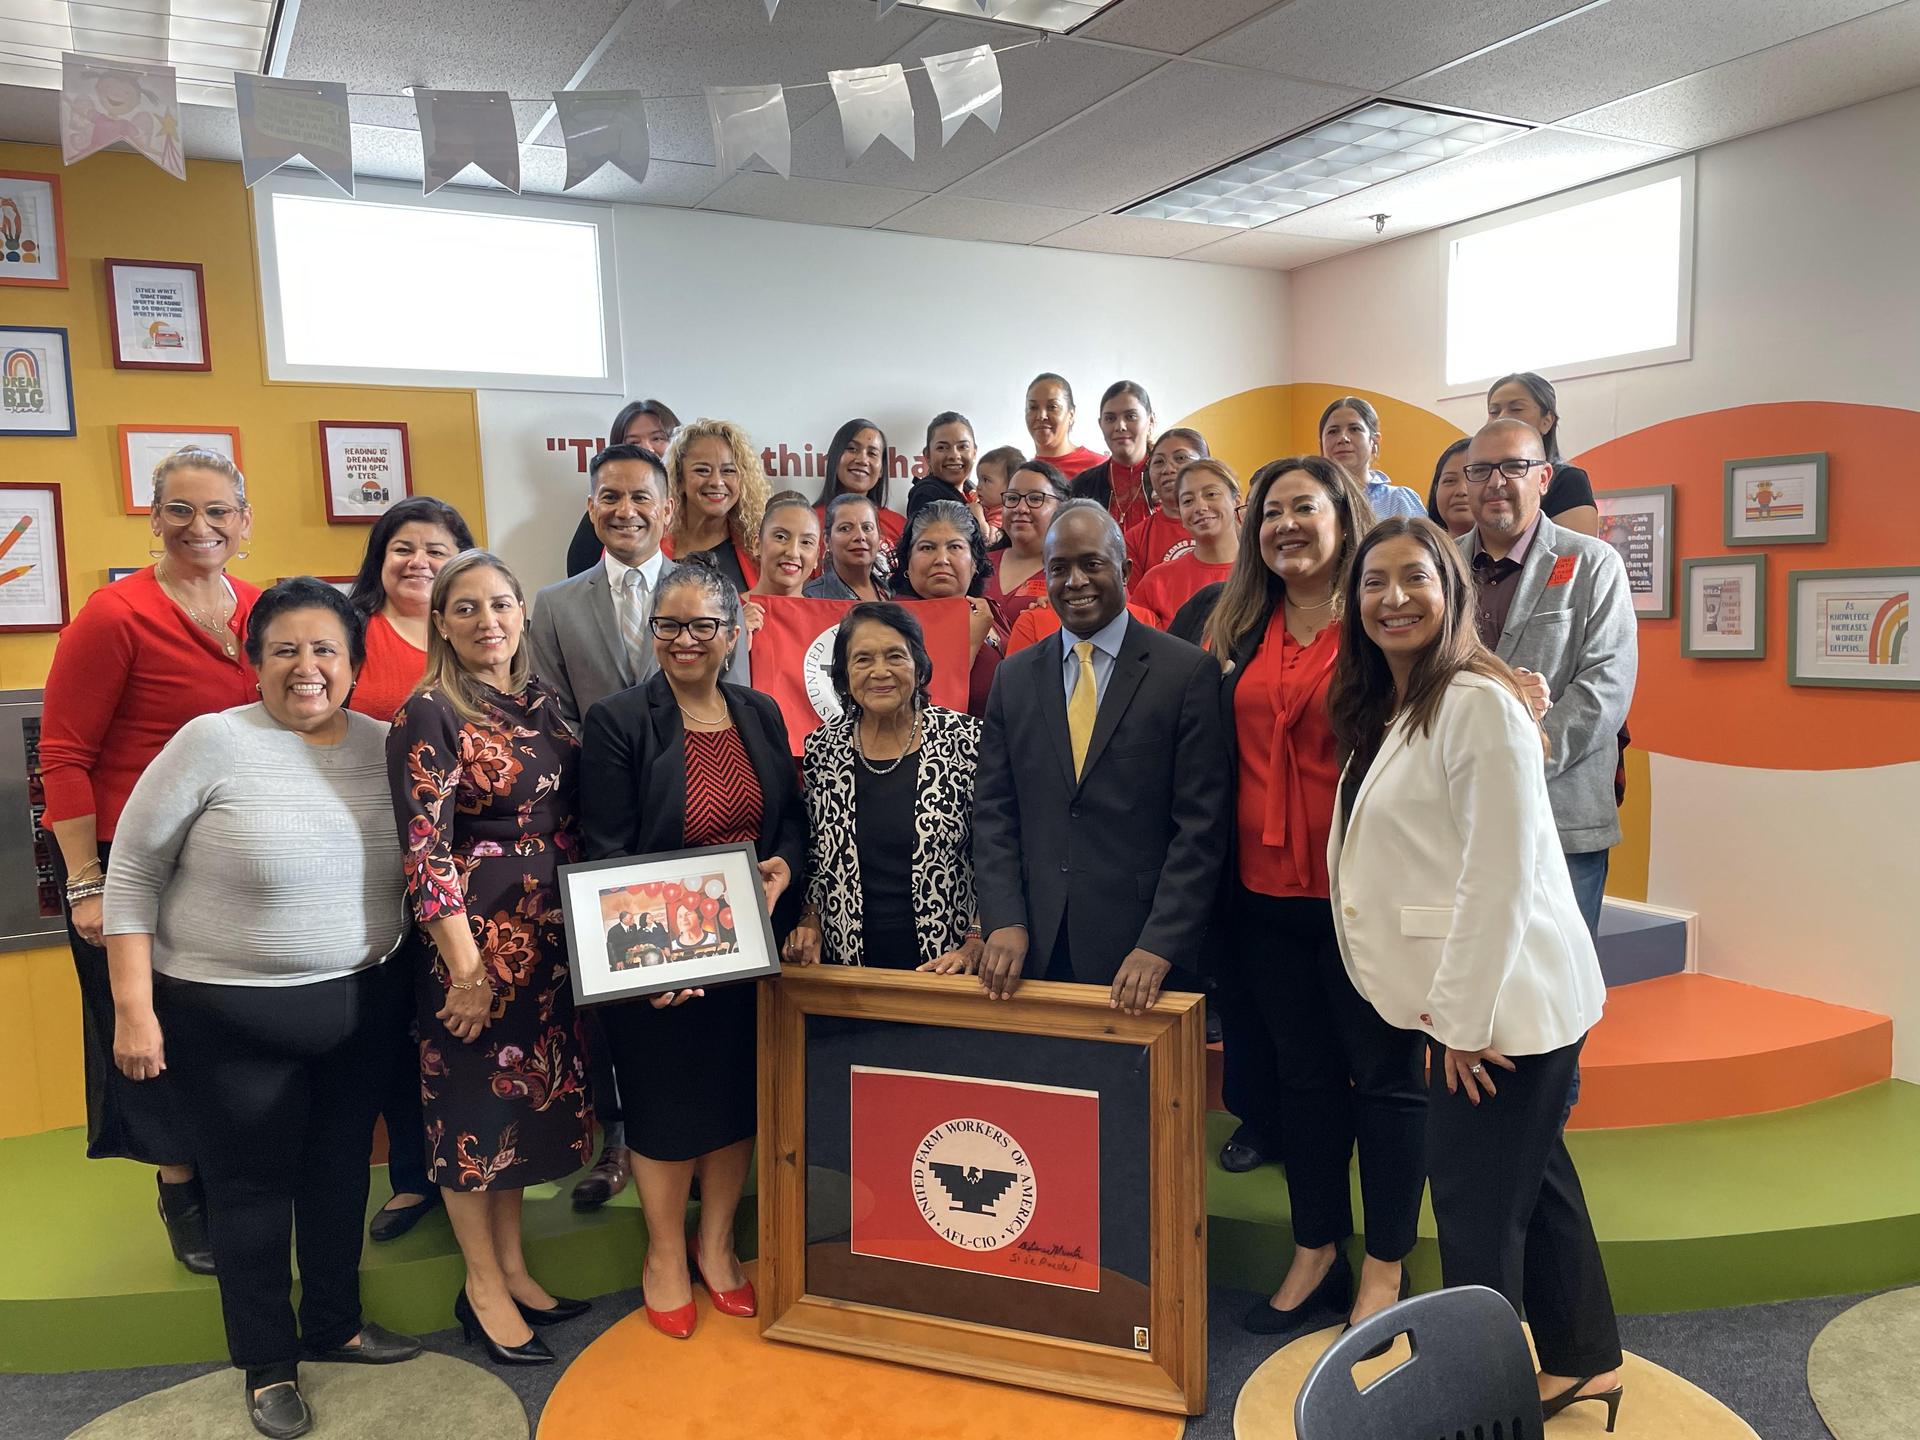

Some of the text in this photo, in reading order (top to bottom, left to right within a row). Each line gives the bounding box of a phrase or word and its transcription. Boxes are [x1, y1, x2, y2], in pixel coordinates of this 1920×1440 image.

[3, 376, 40, 388] DREAM
[3, 388, 44, 408] BIG
[379, 448, 388, 456] IS
[346, 456, 386, 464] DREAMING
[761, 443, 829, 478] thin
[888, 446, 930, 479] ha
[369, 464, 389, 472] OPEN
[1829, 613, 1870, 621] KNOWLEDGE
[1835, 634, 1864, 642] WONDER
[806, 642, 825, 698] UNITED
[914, 1120, 1033, 1236] UNITED FARM WORKERS OF AMERICA
[942, 1227, 997, 1248] AFL-CIO
